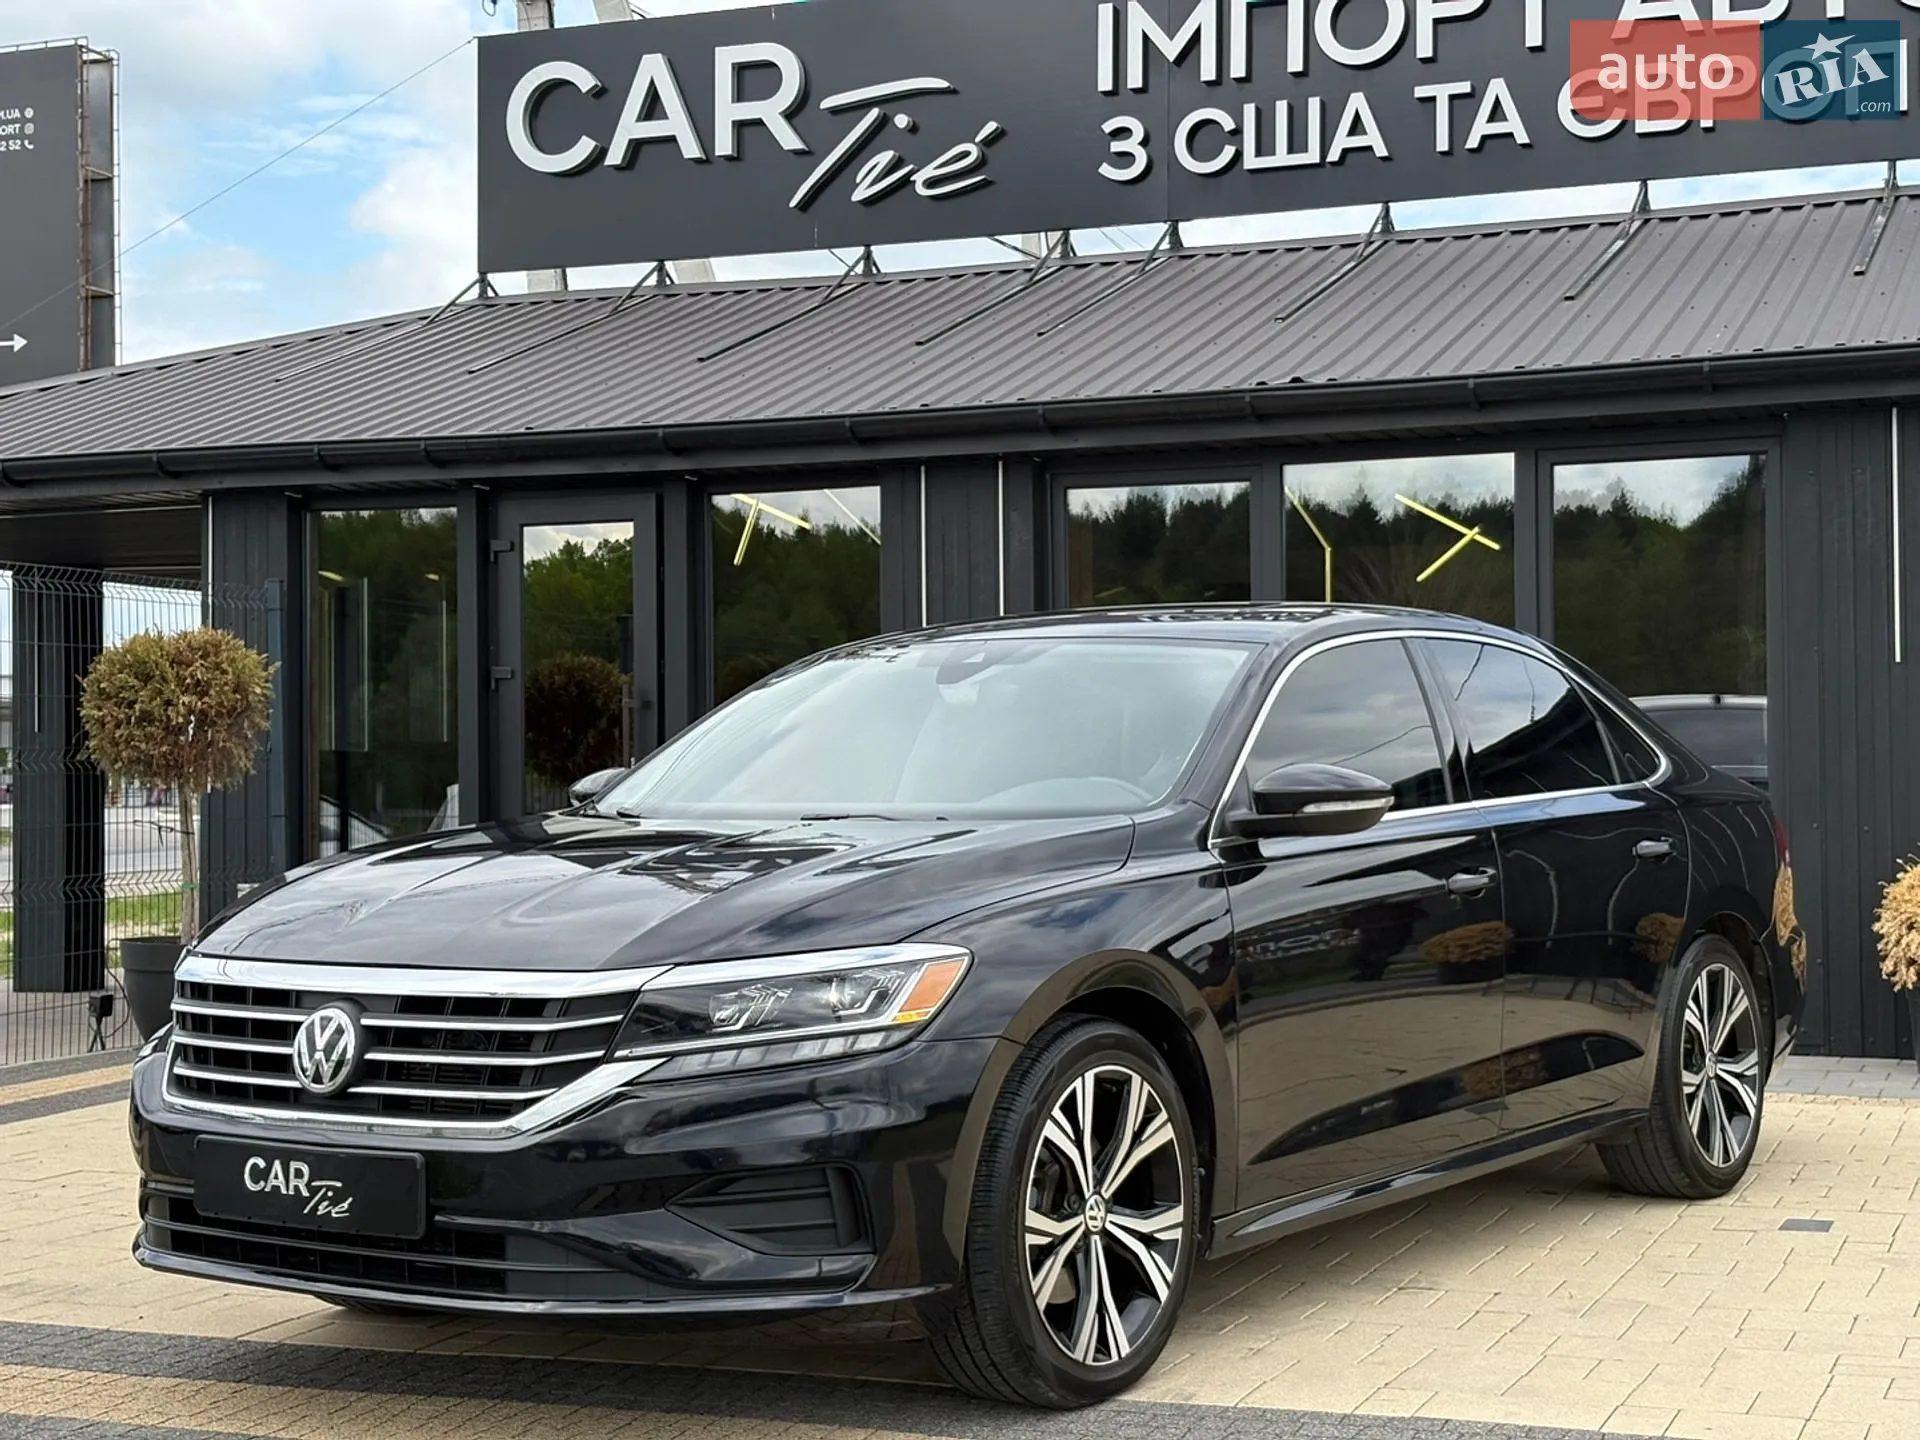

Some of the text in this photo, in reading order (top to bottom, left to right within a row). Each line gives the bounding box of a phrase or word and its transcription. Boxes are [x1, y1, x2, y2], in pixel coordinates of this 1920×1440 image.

[505, 42, 1002, 208] CAR Tié
[1174, 92, 1390, 175] США
[1414, 77, 1531, 151] ТА
[244, 1156, 310, 1197] CAR
